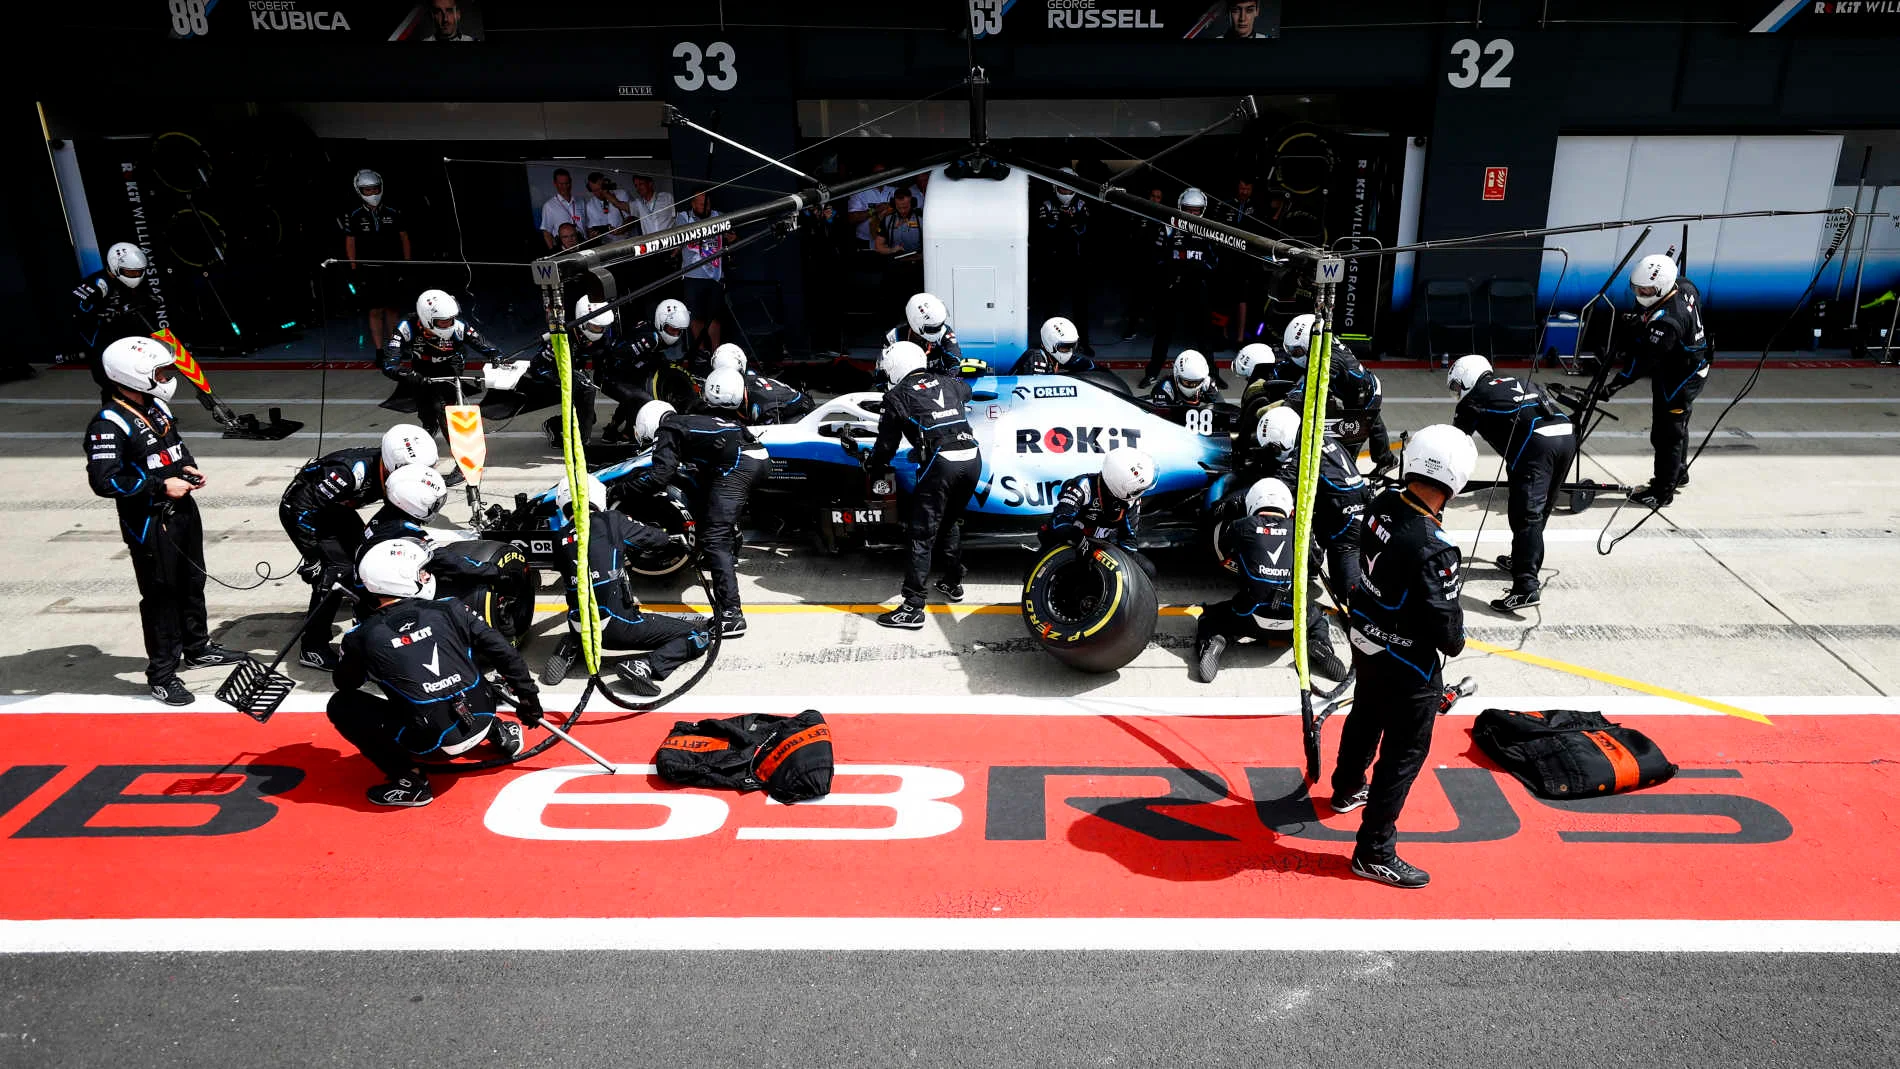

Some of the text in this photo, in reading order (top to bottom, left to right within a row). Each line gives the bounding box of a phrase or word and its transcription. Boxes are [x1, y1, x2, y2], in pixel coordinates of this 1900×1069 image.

[168, 0, 208, 36] 88
[248, 0, 296, 10] ROBERT
[969, 0, 1002, 34] 63
[1047, 0, 1095, 9] GEORGE
[251, 11, 351, 30] KUBICA
[1048, 9, 1164, 28] RUSSELL
[672, 42, 738, 91] 33
[1447, 39, 1514, 88] 32
[661, 229, 701, 248] WILLIAMS
[701, 220, 731, 237] RACING
[1188, 222, 1220, 241] WILLIAMS
[1219, 233, 1246, 251] RACING
[537, 265, 552, 280] W
[1323, 264, 1339, 278] W
[1345, 275, 1358, 328] RACING
[1036, 386, 1076, 397] ORLEN
[1185, 409, 1213, 436] 88
[1016, 427, 1141, 454] ROKiT
[1000, 476, 1062, 507] Sur
[832, 509, 882, 524] ROKiT
[497, 551, 526, 569] ZERO
[1025, 600, 1062, 640] ZERO
[422, 673, 462, 693] Rexona
[483, 764, 965, 841] 63
[985, 765, 1793, 844] RUS
